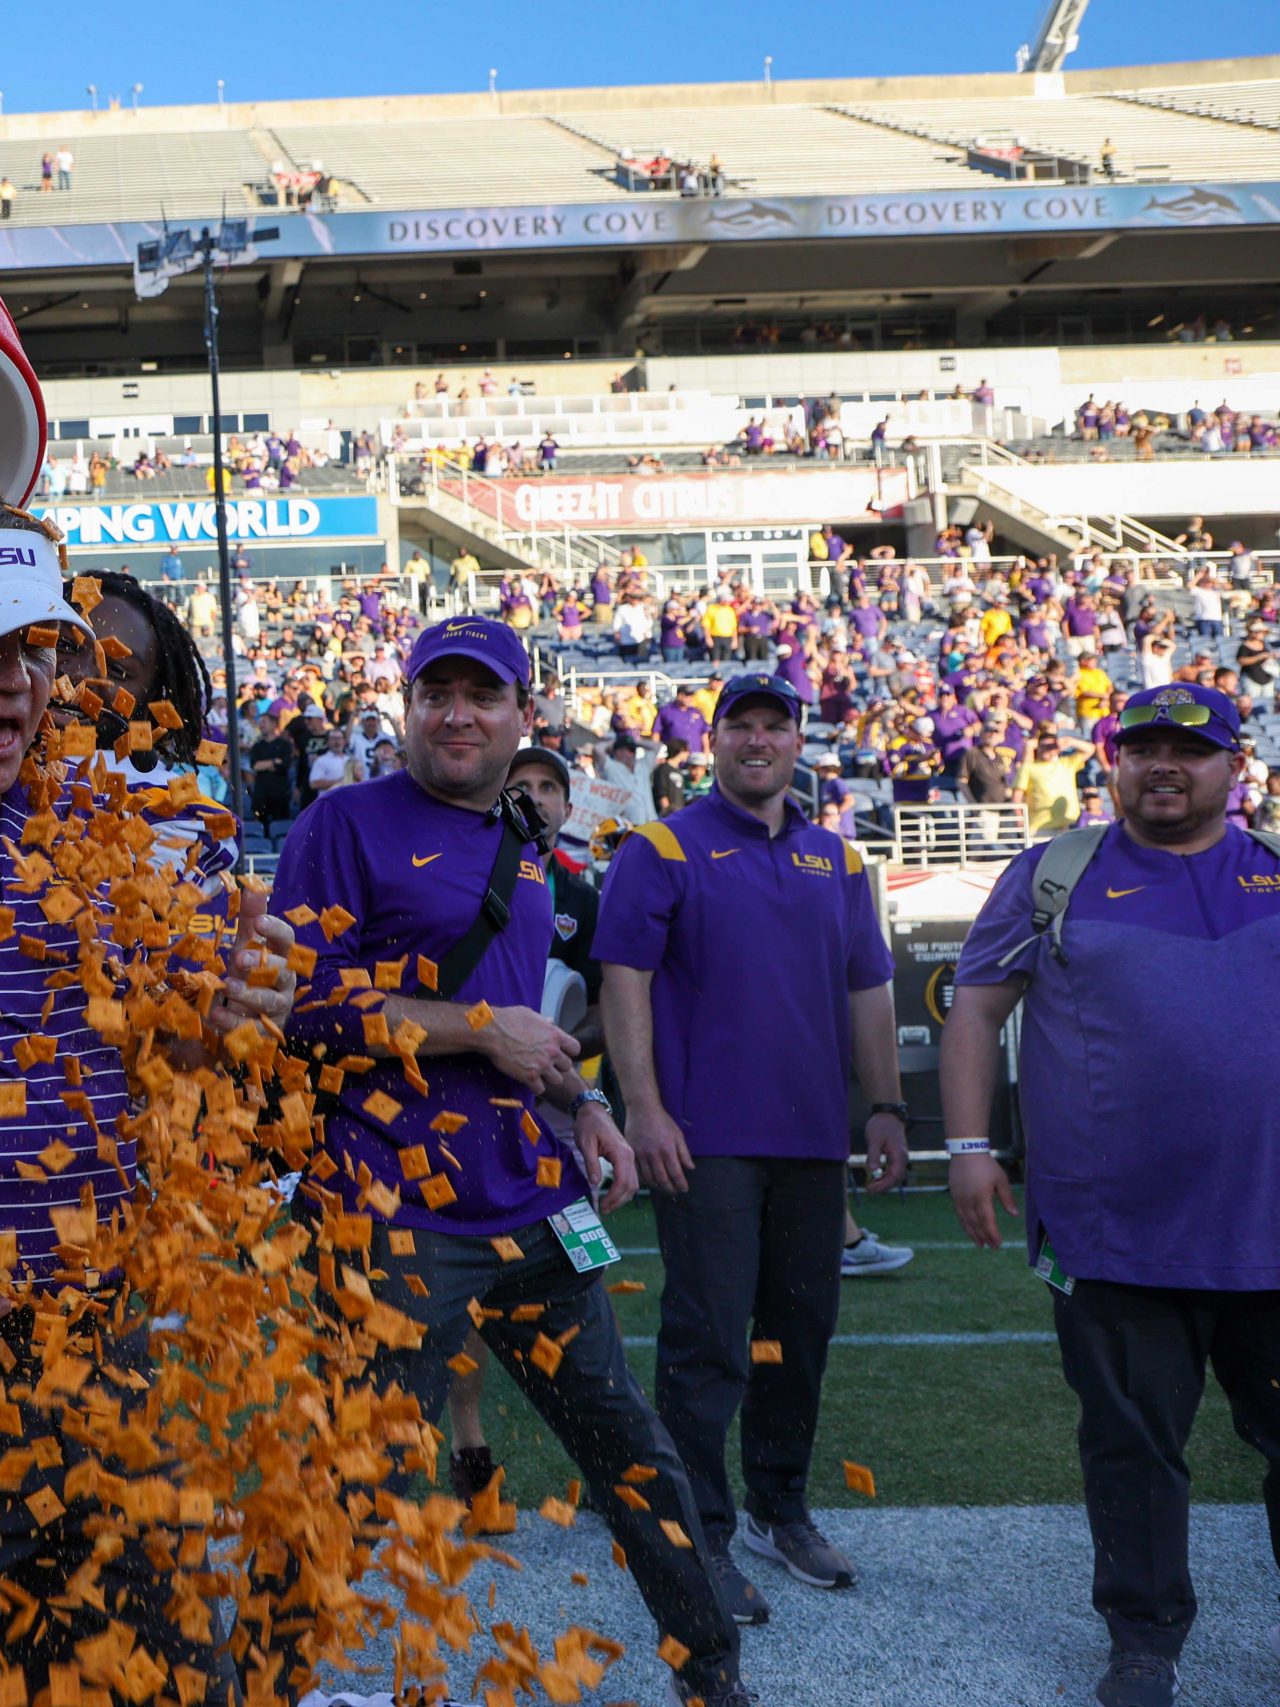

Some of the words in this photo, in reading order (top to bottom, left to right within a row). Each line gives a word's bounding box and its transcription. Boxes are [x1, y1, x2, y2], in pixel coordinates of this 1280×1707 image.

[826, 200, 1007, 227] DISCOVERY
[1023, 196, 1113, 221] COVE
[388, 214, 567, 242] DISCOVERY
[582, 210, 670, 234] COVE
[632, 480, 735, 521] CITRUS
[158, 499, 320, 541] WORLD
[465, 629, 488, 641] TIGERS
[517, 860, 545, 885] SU
[791, 852, 833, 872] LSU
[1237, 874, 1280, 888] LSU
